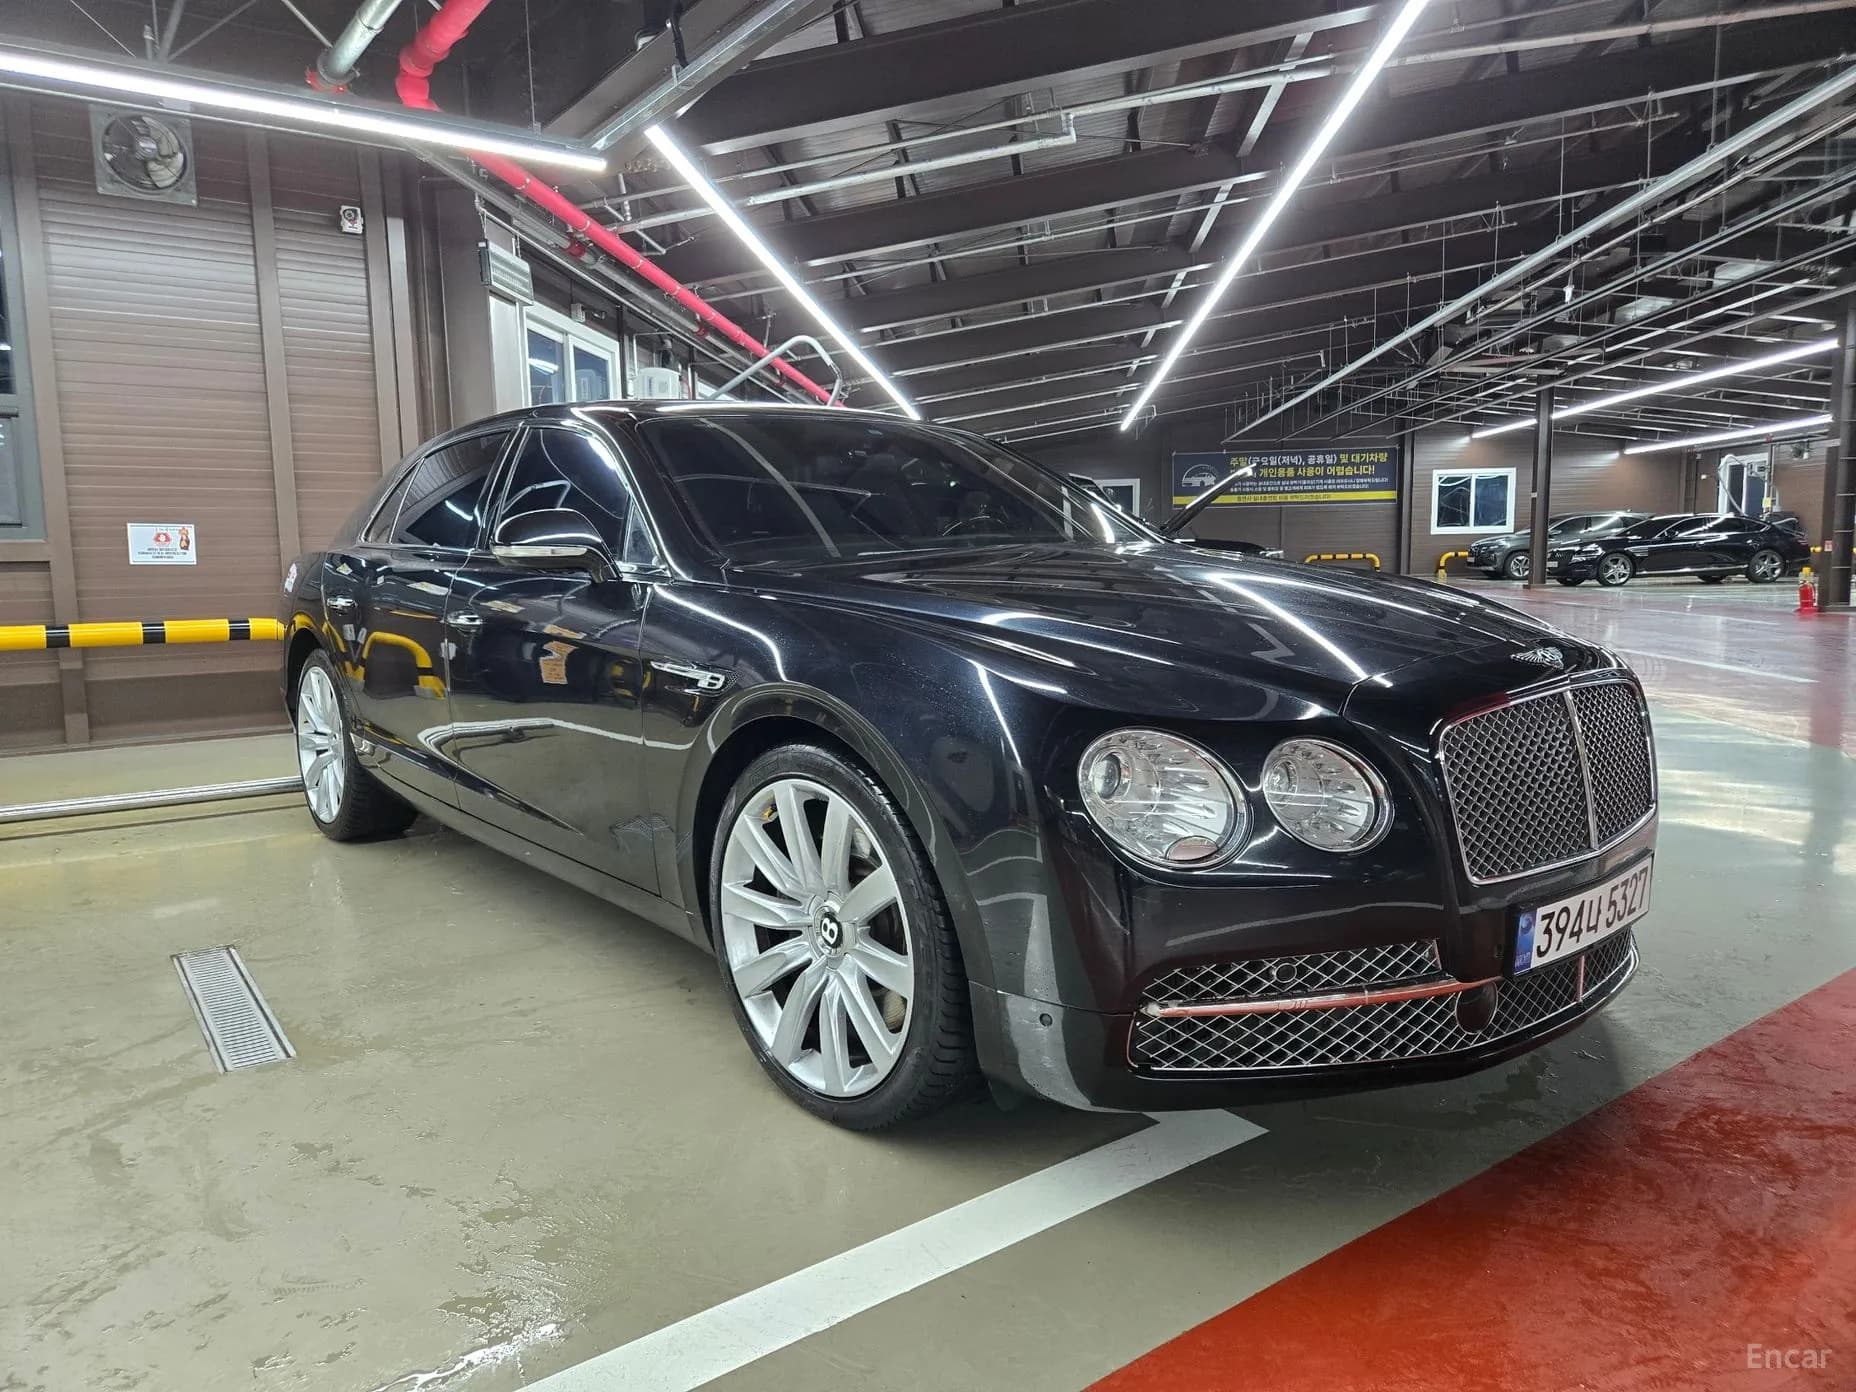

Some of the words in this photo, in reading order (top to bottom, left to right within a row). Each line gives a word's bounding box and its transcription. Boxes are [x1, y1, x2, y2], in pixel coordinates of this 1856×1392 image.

[1308, 454, 1337, 465] 공휴일)
[1340, 453, 1348, 464] 및
[1351, 452, 1388, 463] 대기차량
[1297, 466, 1324, 477] 사용이
[1327, 464, 1375, 476] 어렵습니다!
[1605, 866, 1649, 929] 5327
